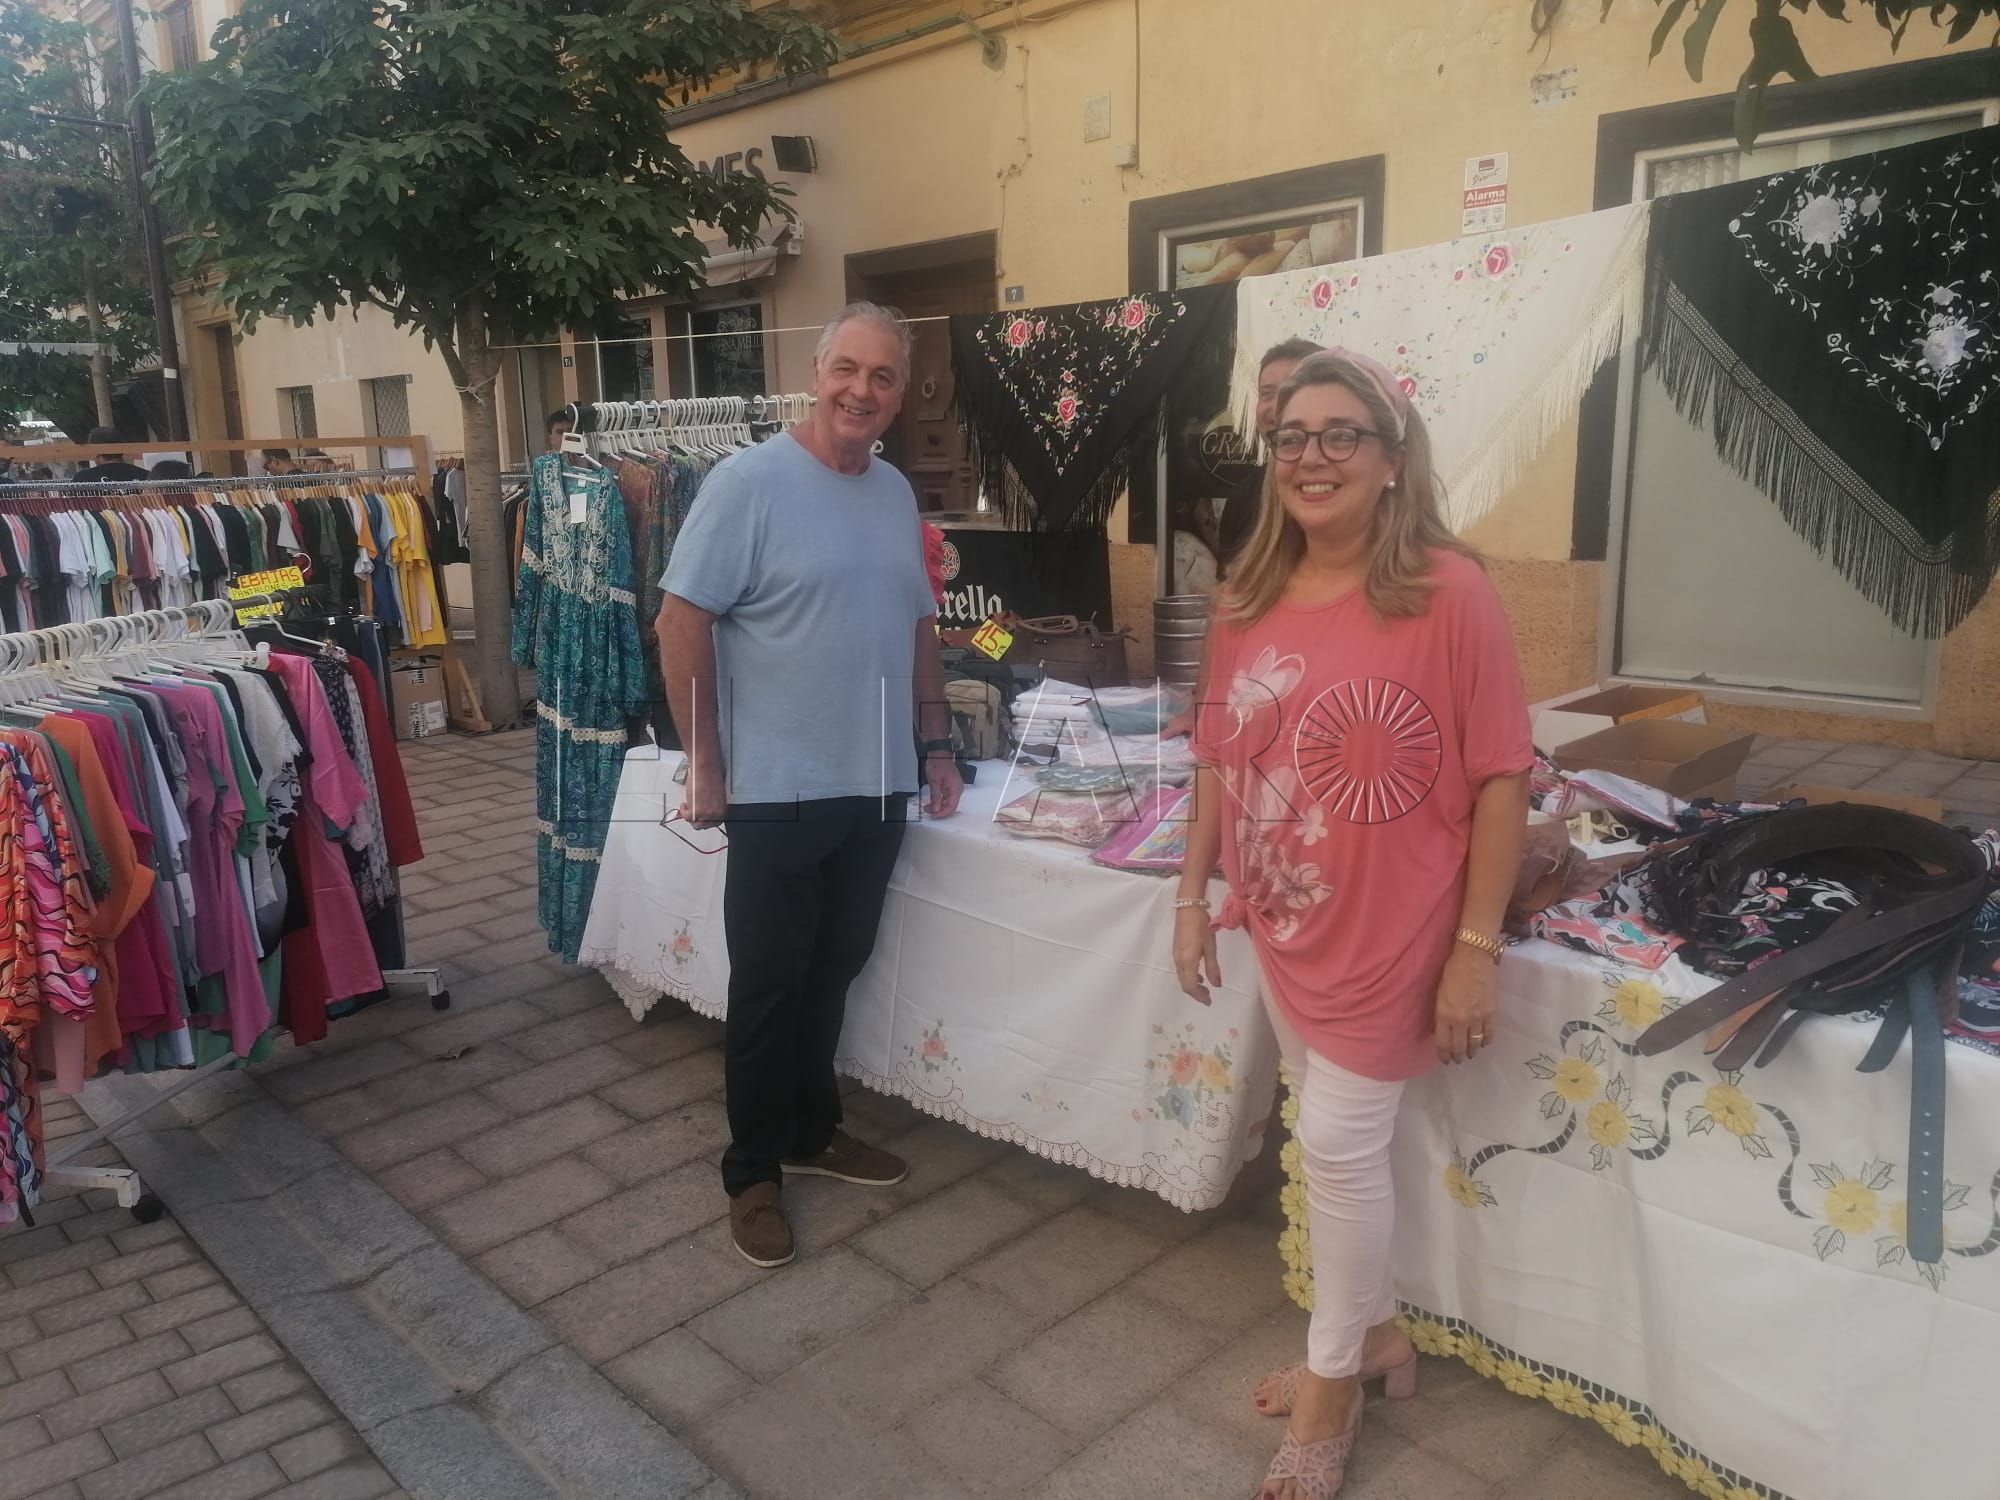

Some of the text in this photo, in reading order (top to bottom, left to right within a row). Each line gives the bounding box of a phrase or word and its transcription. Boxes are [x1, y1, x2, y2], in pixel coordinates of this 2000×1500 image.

[696, 147, 767, 187] MES
[1466, 189, 1505, 202] Alarma
[239, 567, 300, 589] EBAJAS
[935, 584, 1003, 622] rella
